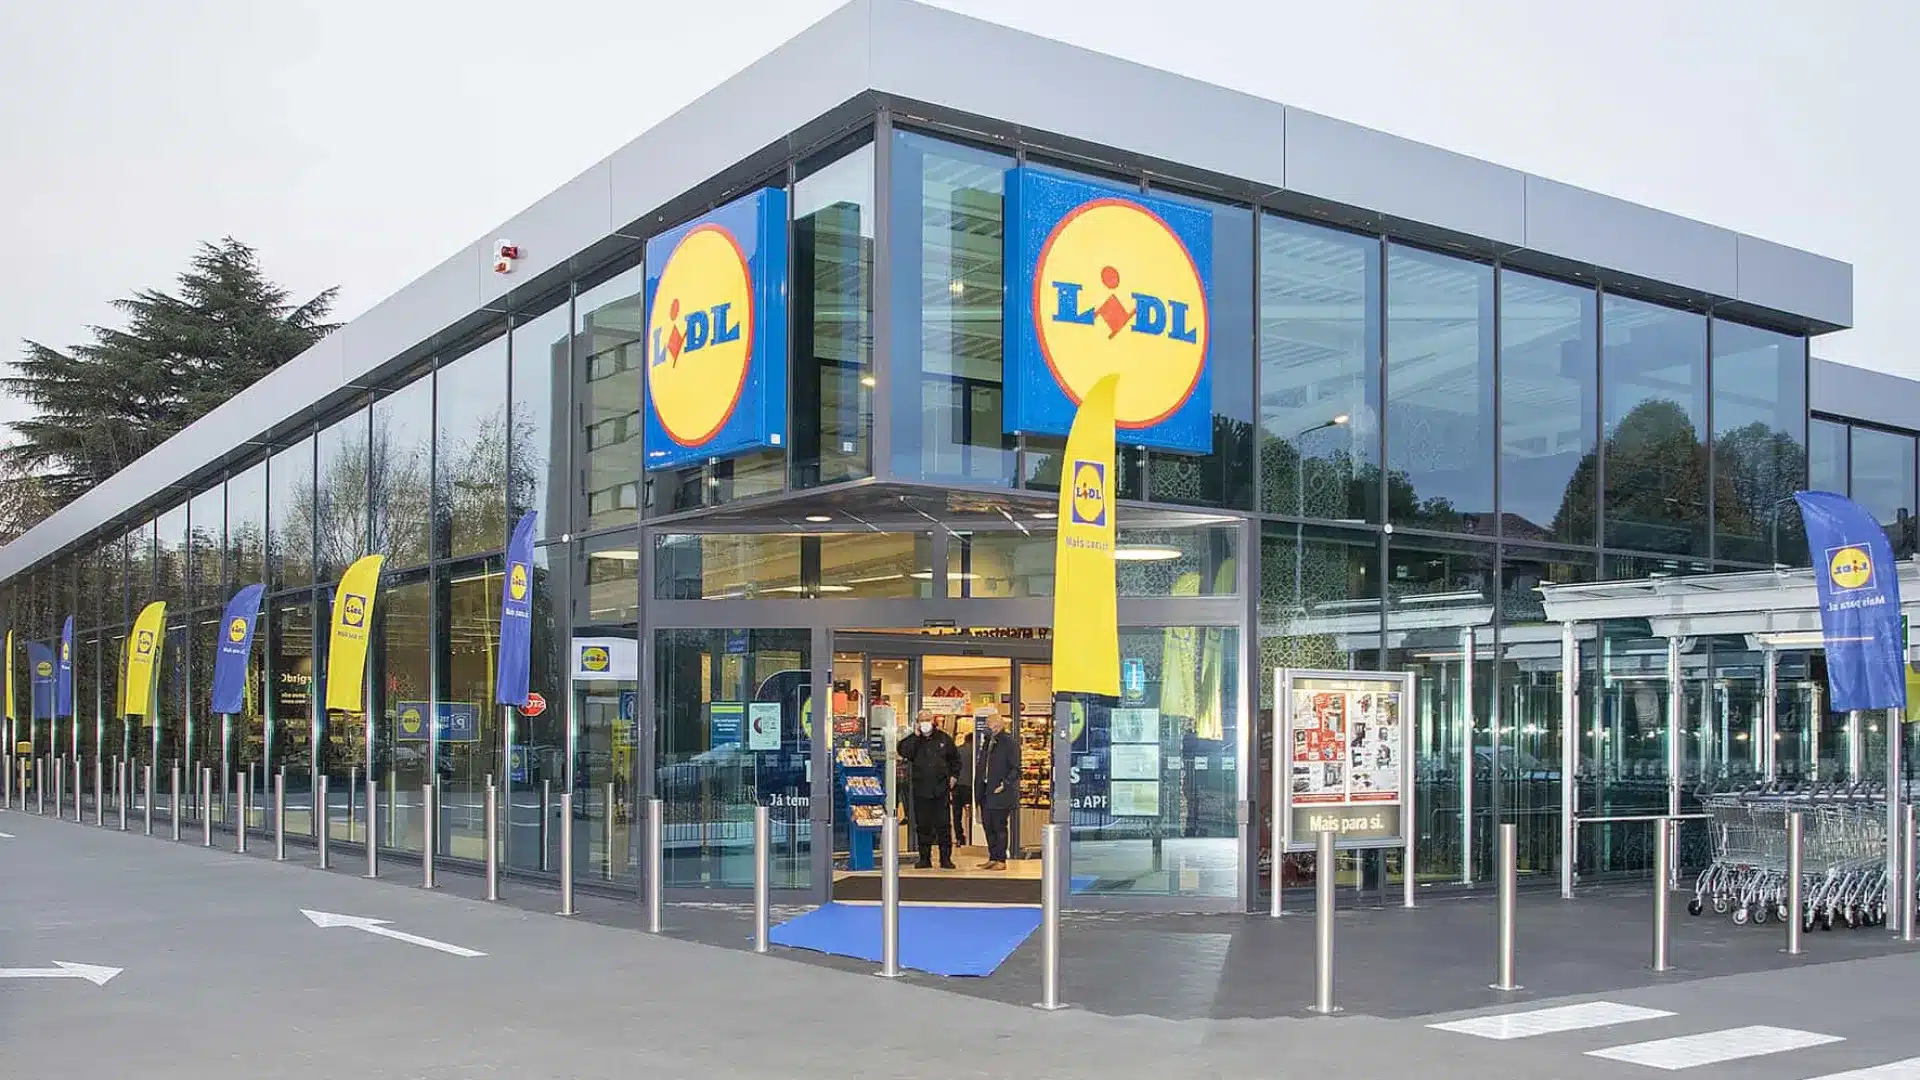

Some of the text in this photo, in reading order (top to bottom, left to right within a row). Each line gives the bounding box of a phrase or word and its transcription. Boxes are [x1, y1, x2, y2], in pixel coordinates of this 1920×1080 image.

[770, 793, 809, 807] Já tem
[1309, 814, 1385, 834] Mais para si.
